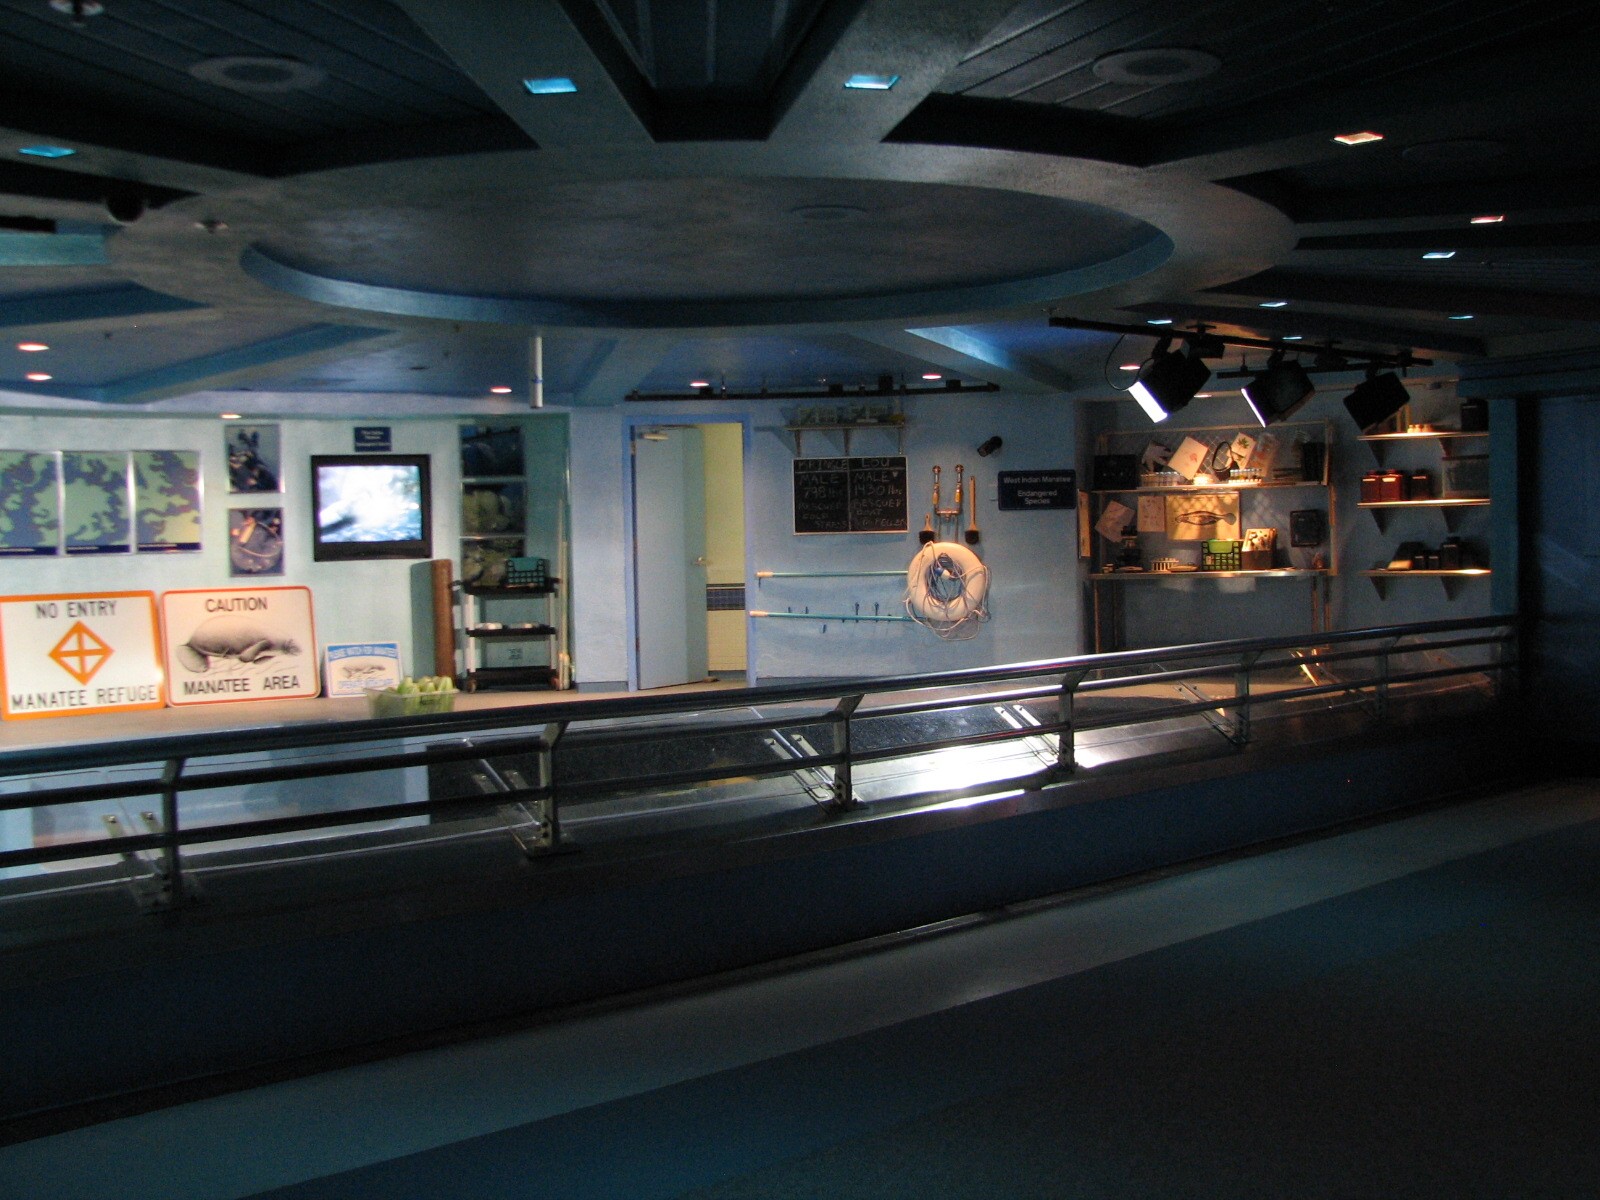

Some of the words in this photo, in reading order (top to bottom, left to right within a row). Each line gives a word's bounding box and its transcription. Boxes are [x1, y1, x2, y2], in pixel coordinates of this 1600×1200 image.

[799, 473, 839, 486] MALE
[853, 470, 890, 484] MALE
[1003, 475, 1021, 484] West
[1022, 475, 1041, 484] Indian
[1042, 475, 1072, 483] Manatee
[803, 486, 827, 499] 798
[854, 483, 886, 497] 1430
[1017, 489, 1058, 498] Endangered
[1024, 497, 1051, 506] Species
[36, 602, 58, 619] NO
[67, 600, 118, 618] ENTRY
[204, 596, 268, 613] CAUTION
[183, 678, 251, 696] MANATEE
[262, 675, 300, 691] AREA
[11, 690, 88, 711] MANATEE
[96, 684, 158, 705] REFUGE
